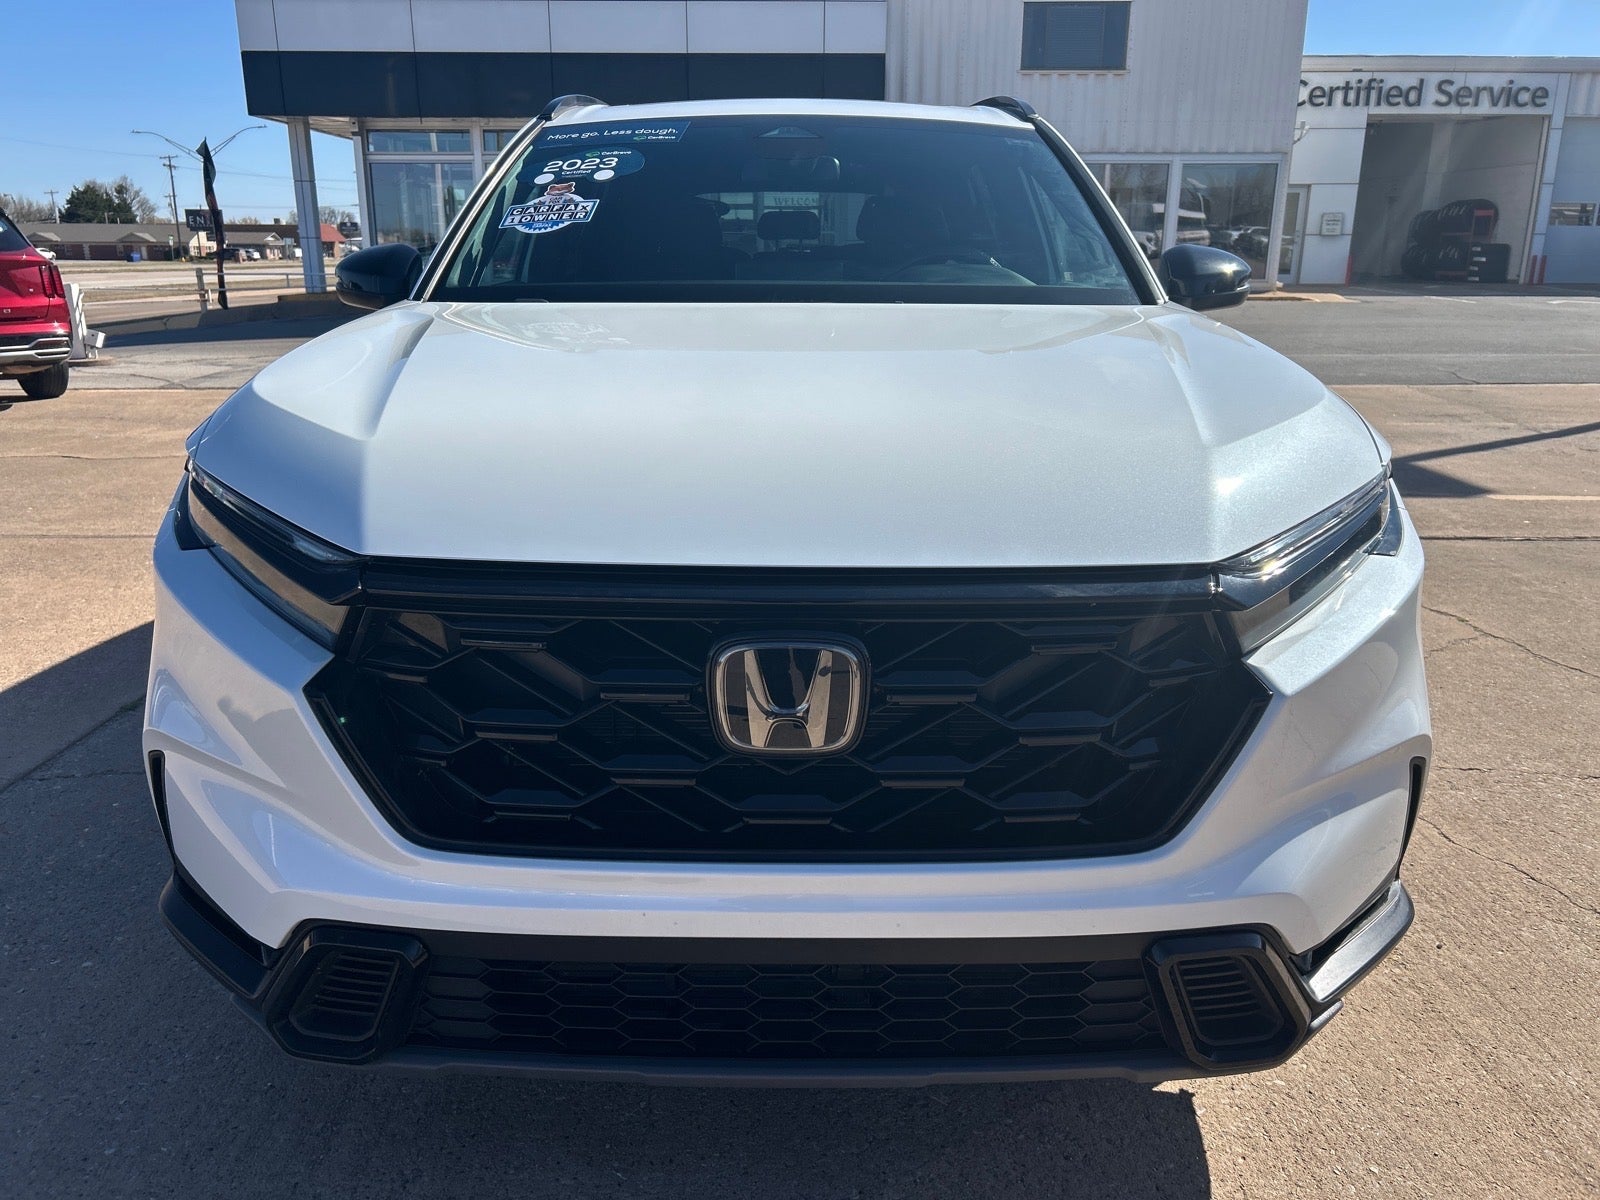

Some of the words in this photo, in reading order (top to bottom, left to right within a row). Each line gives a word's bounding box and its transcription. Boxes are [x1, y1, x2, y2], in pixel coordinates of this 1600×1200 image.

[1432, 79, 1549, 108] Service
[547, 131, 580, 140] More
[580, 132, 600, 140] go.
[635, 127, 679, 135] dough.
[542, 157, 619, 173] 2023
[512, 203, 590, 215] CARFAX
[520, 211, 586, 222] OWNER
